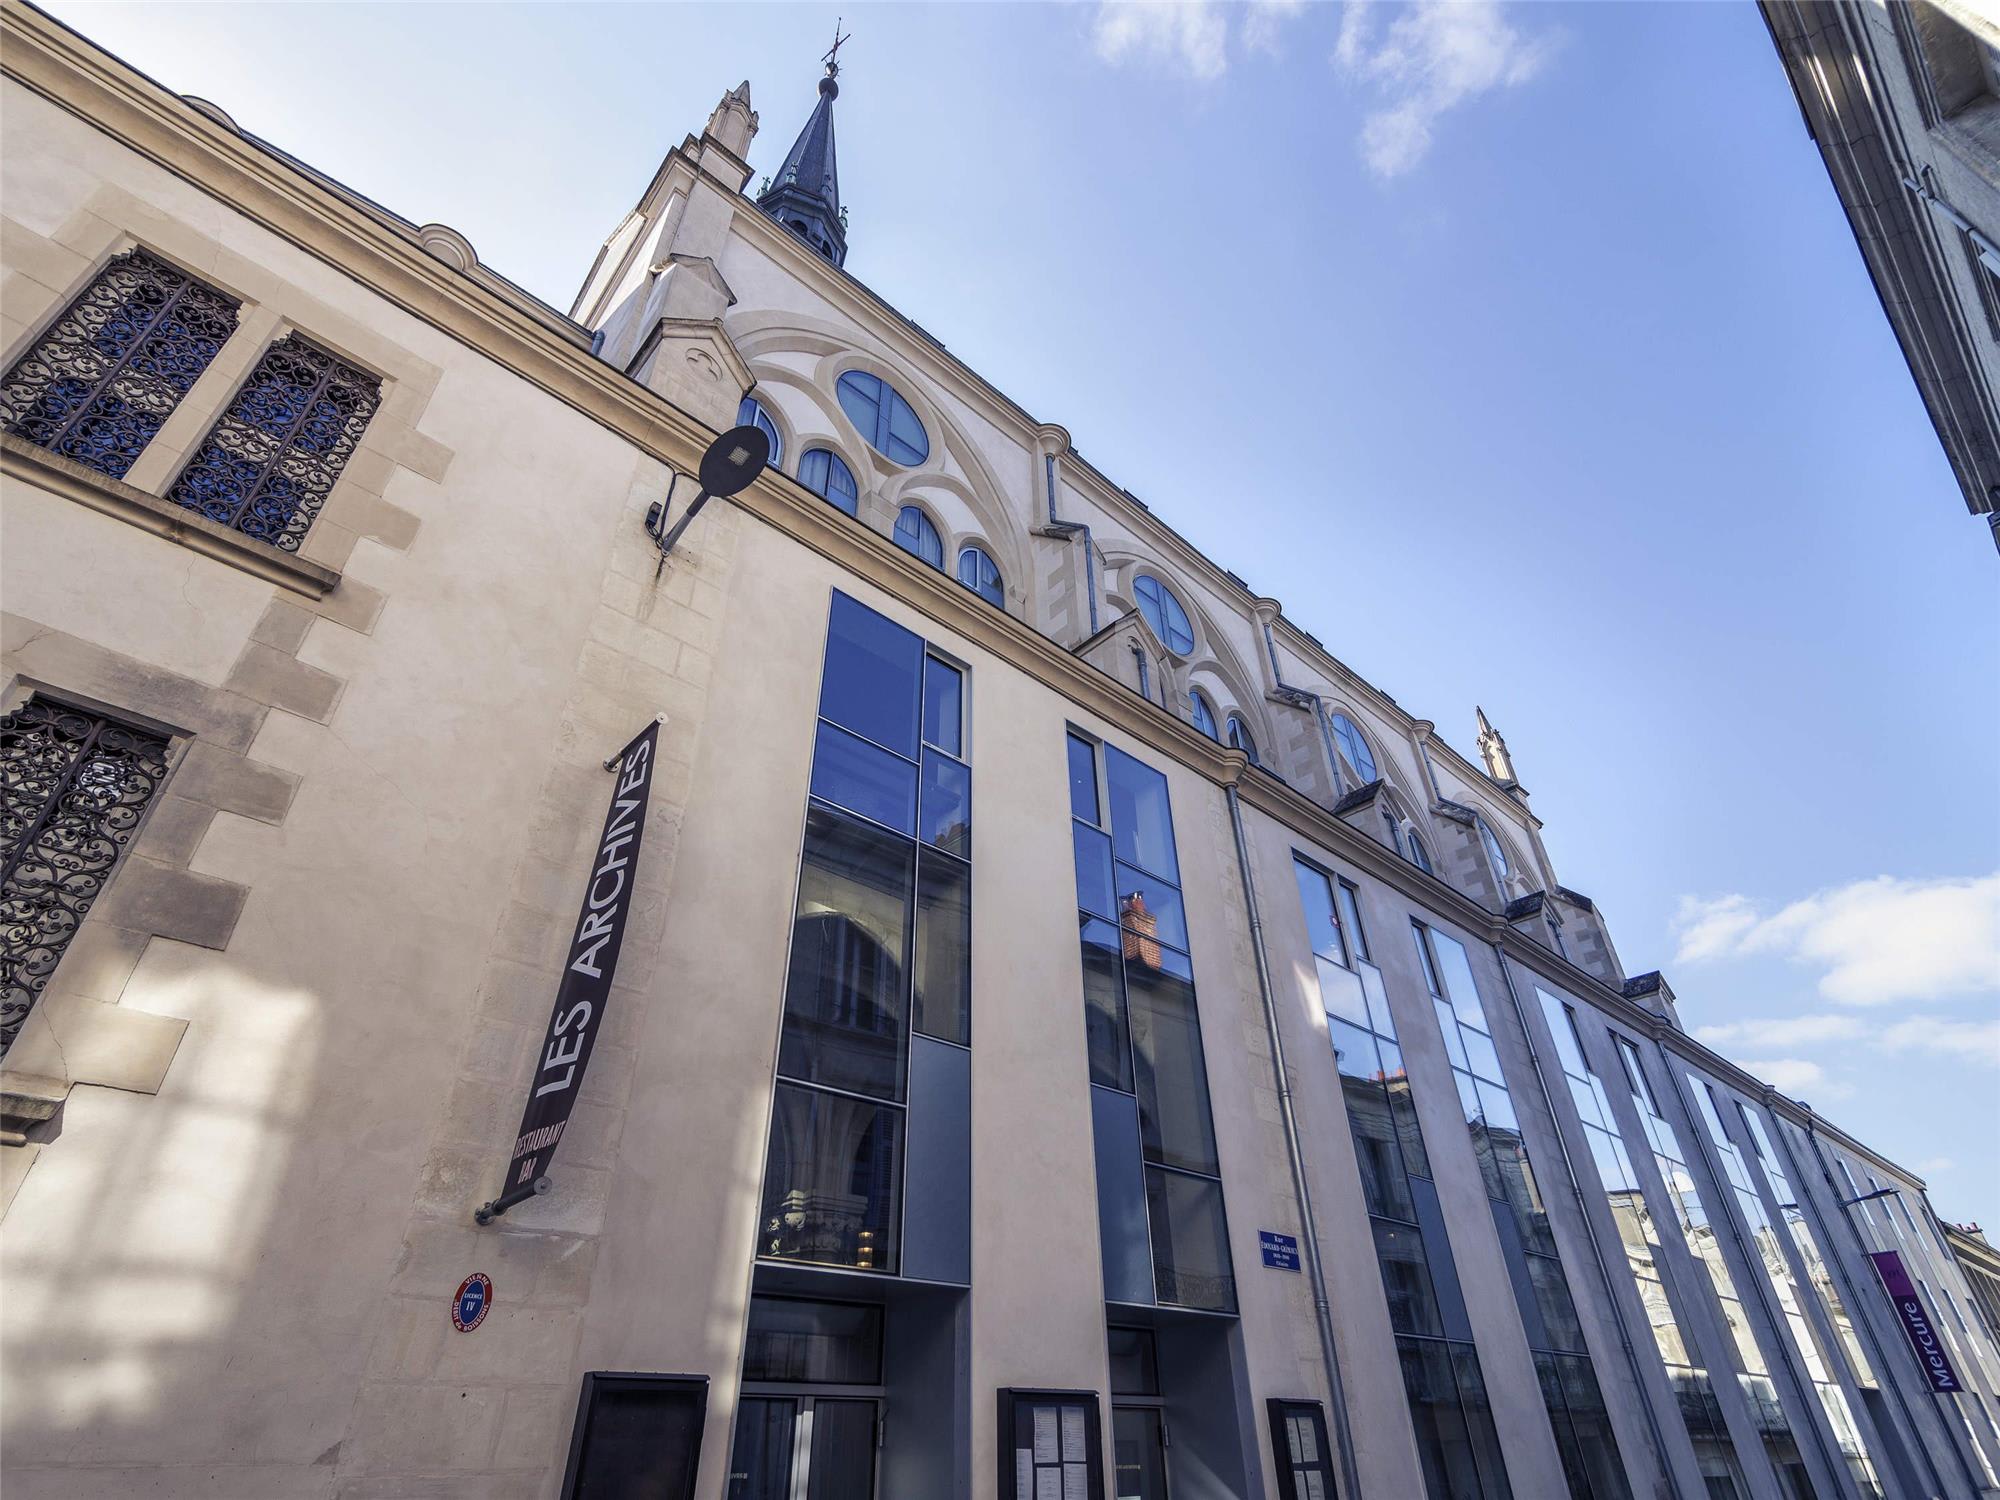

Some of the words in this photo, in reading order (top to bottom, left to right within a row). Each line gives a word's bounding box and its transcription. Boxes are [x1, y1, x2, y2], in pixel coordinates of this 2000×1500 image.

[536, 1000, 593, 1099] LES
[569, 739, 651, 979] ARCHIVES
[465, 1274, 489, 1285] VIENNE
[465, 1301, 476, 1311] IV
[1904, 1301, 1954, 1387] Mercure
